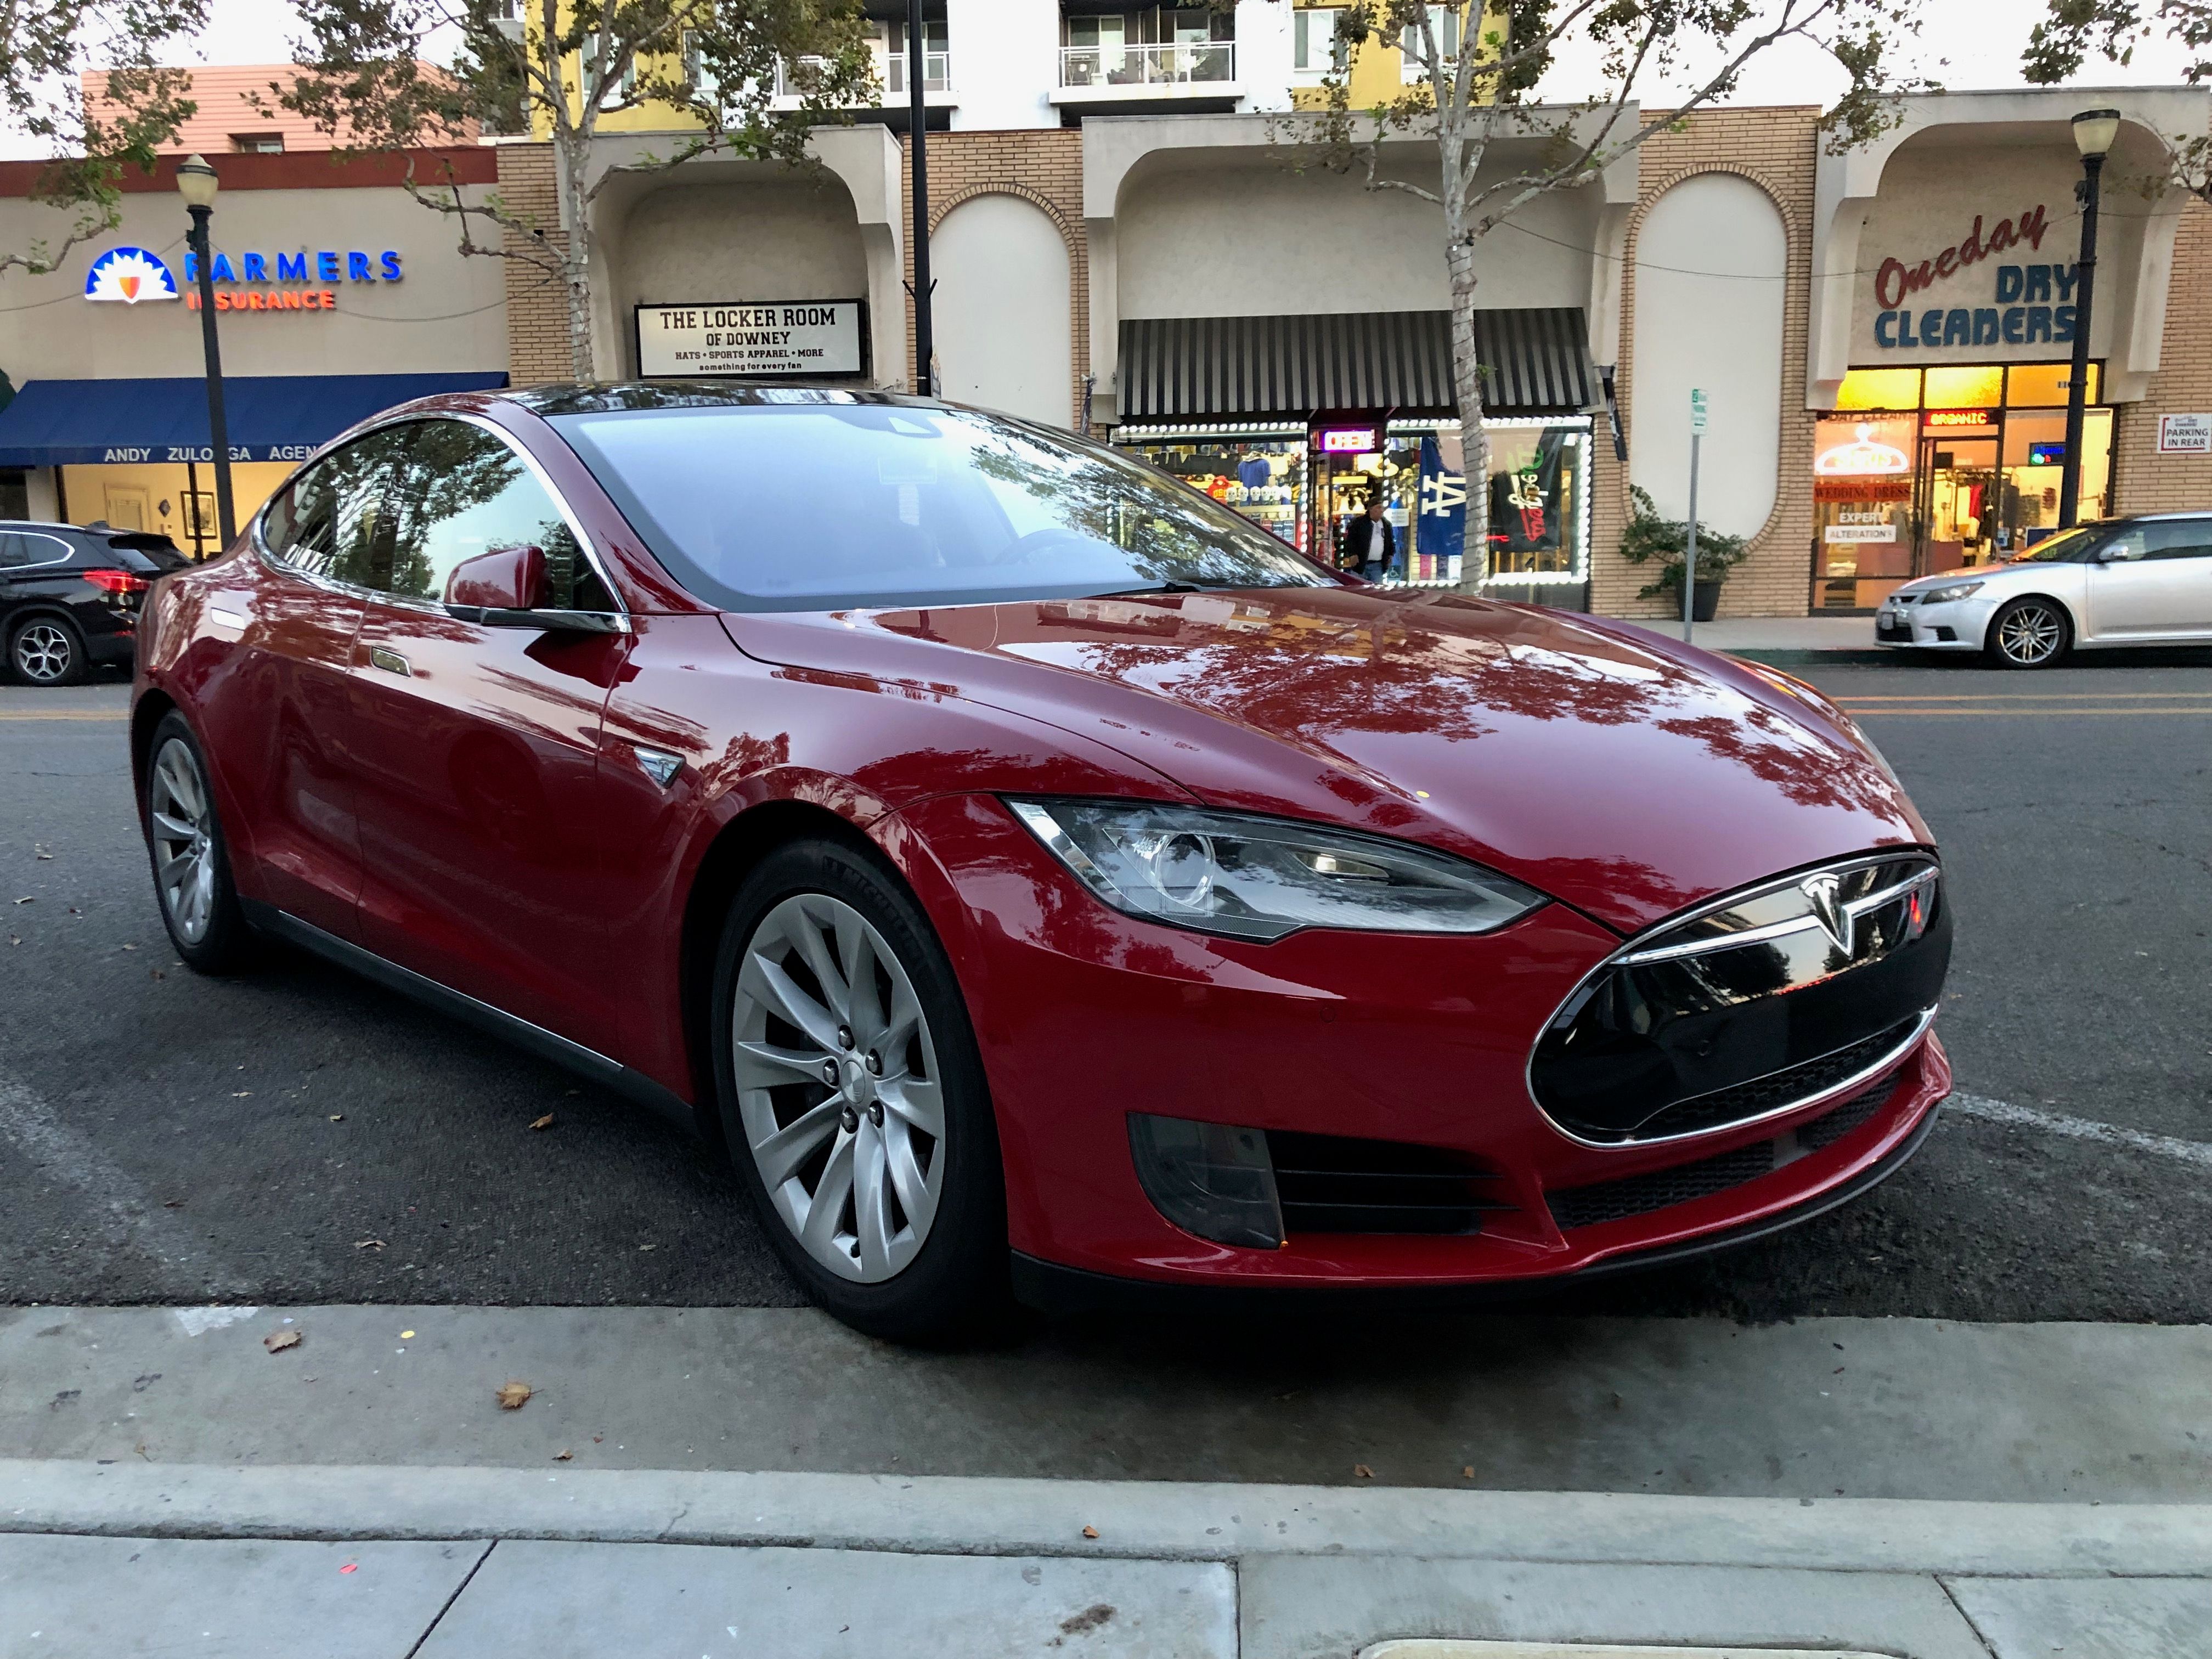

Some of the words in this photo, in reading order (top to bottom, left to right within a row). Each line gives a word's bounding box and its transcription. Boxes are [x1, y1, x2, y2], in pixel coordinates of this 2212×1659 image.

[184, 251, 401, 282] FARMERS
[1875, 204, 2049, 309] Oneday
[1996, 264, 2080, 303] DRY
[187, 290, 334, 310] ISURANCE
[660, 311, 697, 329] THE
[703, 308, 777, 328] LOCKER
[783, 307, 836, 327] ROOM
[1875, 306, 2078, 348] CLEANERS
[706, 332, 722, 346] OF
[726, 331, 791, 346] DOWNEY
[675, 351, 701, 360] HATS
[709, 350, 744, 359] SPORTS
[747, 349, 789, 359] APPAREL
[798, 348, 823, 357] MORE
[2166, 428, 2209, 437] PARKING
[105, 448, 151, 462] ANDY
[167, 447, 252, 461] ZULOGA
[1839, 512, 1883, 523] EXPERT
